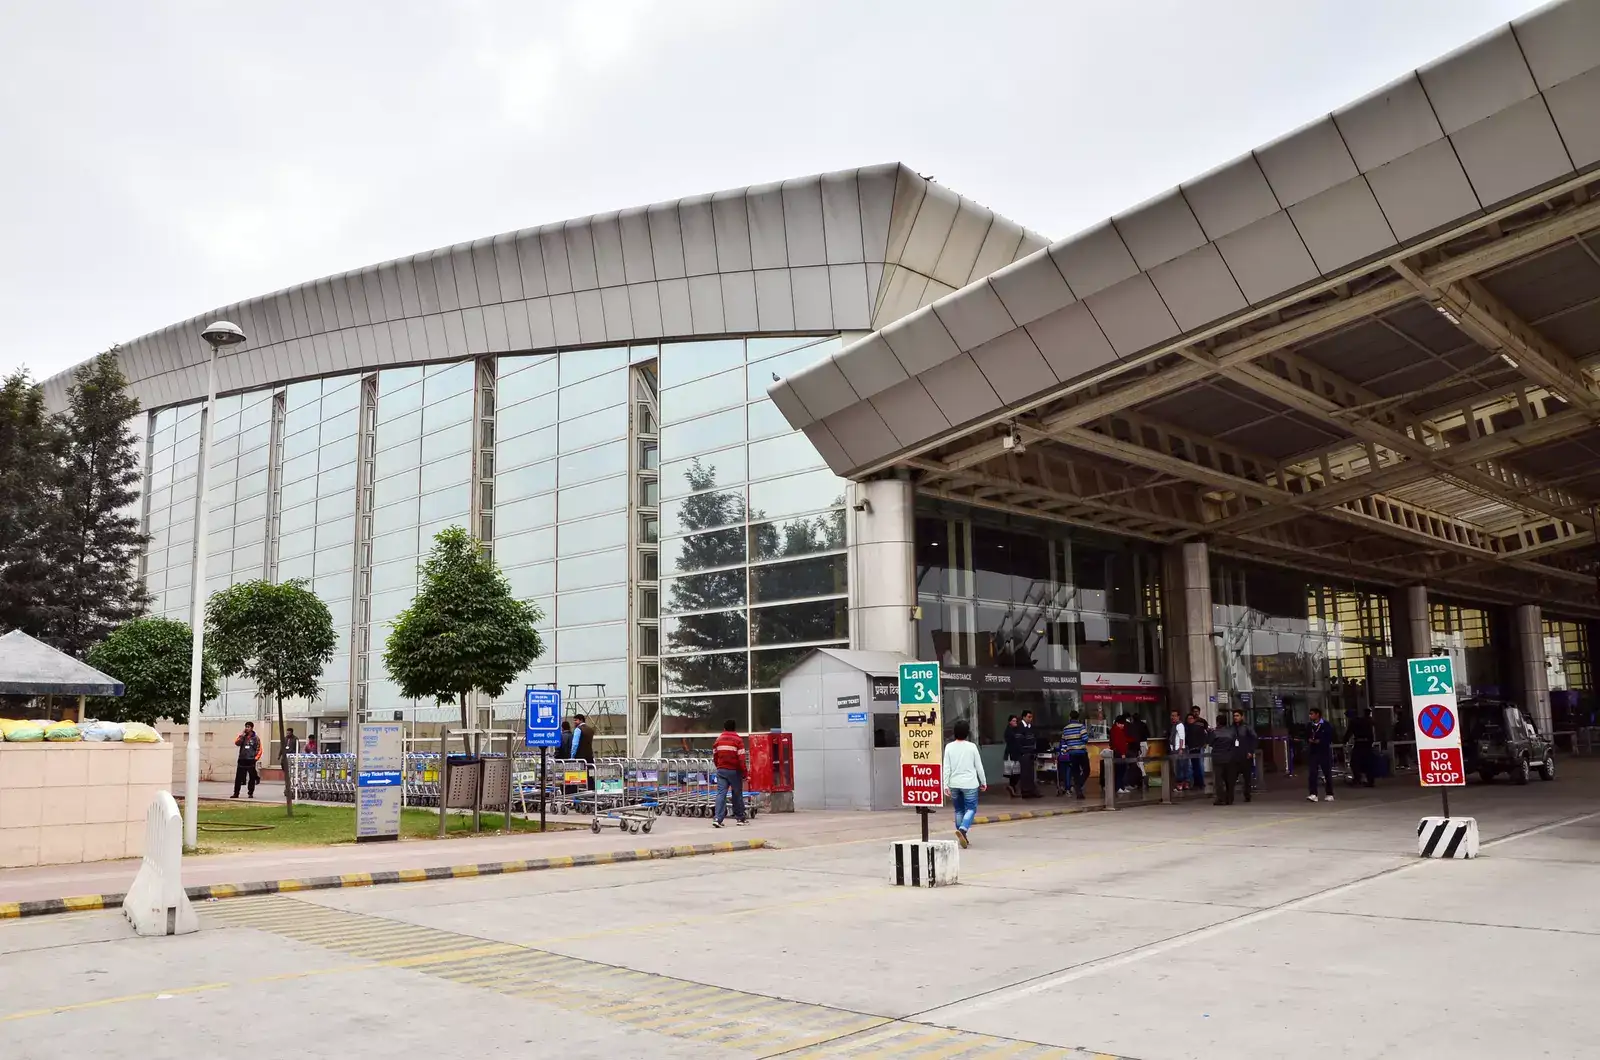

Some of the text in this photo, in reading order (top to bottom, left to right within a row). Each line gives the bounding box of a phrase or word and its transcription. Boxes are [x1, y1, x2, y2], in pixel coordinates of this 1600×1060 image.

[904, 668, 933, 679] Lane
[1415, 664, 1447, 674] Lane
[1427, 675, 1440, 692] 2
[914, 682, 925, 700] 3
[909, 730, 933, 738] DROP
[913, 741, 930, 749] OFF
[913, 751, 930, 759] BAY
[1431, 751, 1448, 760] Do
[911, 765, 932, 775] Two
[1431, 761, 1452, 771] Not
[1426, 772, 1459, 783] STOP
[908, 791, 938, 802] STOP
